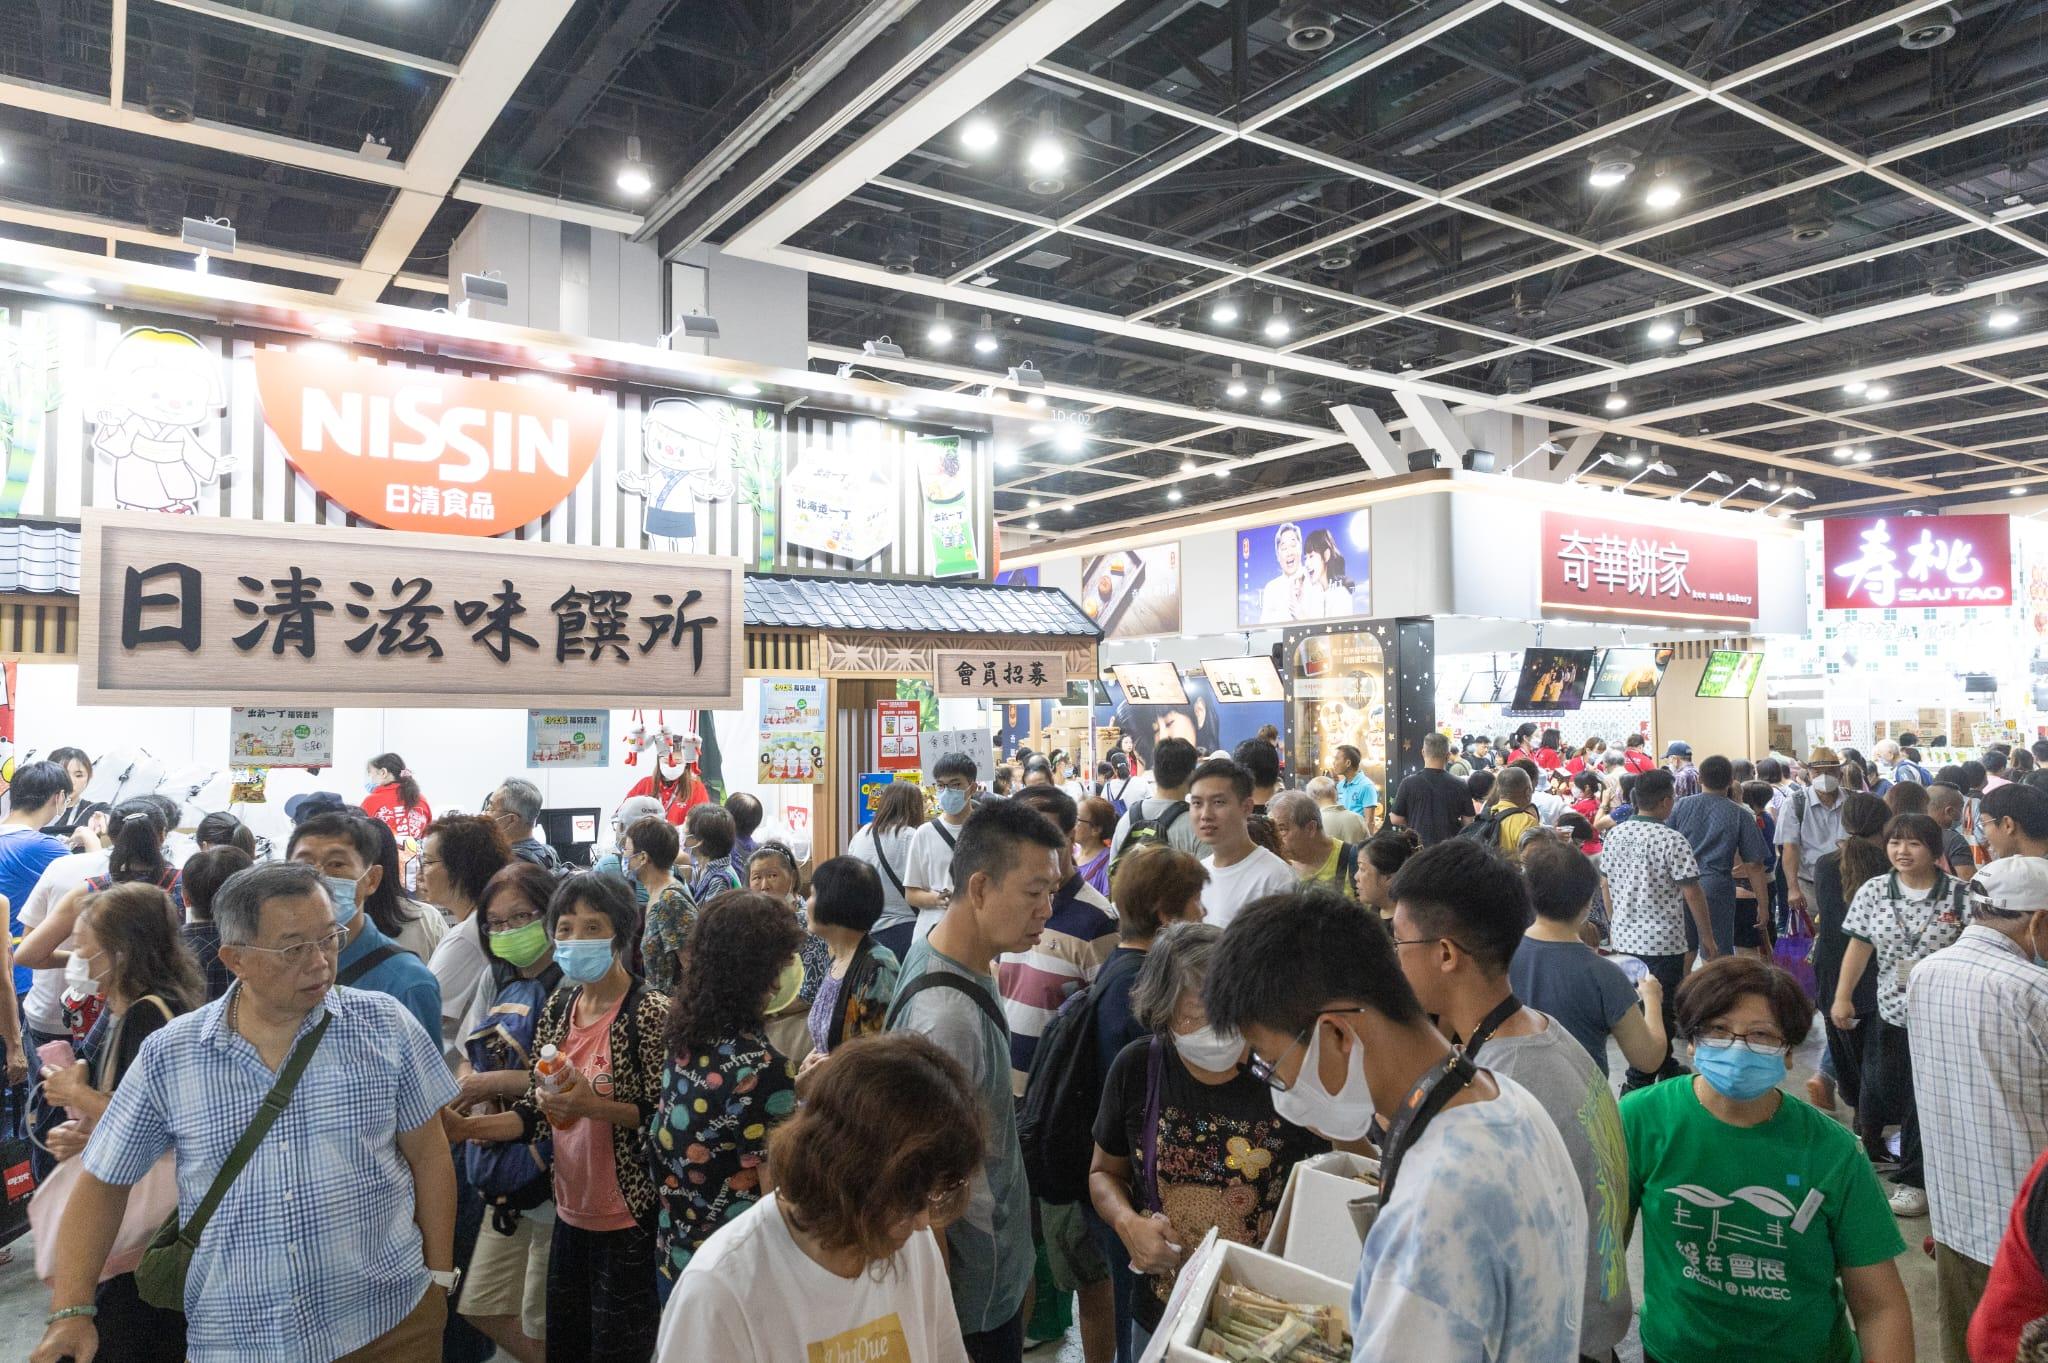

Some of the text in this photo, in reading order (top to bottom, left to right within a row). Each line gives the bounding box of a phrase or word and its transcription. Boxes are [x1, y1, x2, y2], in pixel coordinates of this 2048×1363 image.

[301, 385, 569, 484] NISSIN
[385, 483, 495, 521] 日清食品
[796, 498, 852, 520] 北海道一丁
[1557, 529, 1691, 598] 奇華餅家
[1897, 586, 2005, 602] SAUTAO
[121, 562, 718, 676] 日清滋味饌所
[955, 660, 1048, 688] 會員招募
[1740, 1285, 1792, 1301] HKCEC
